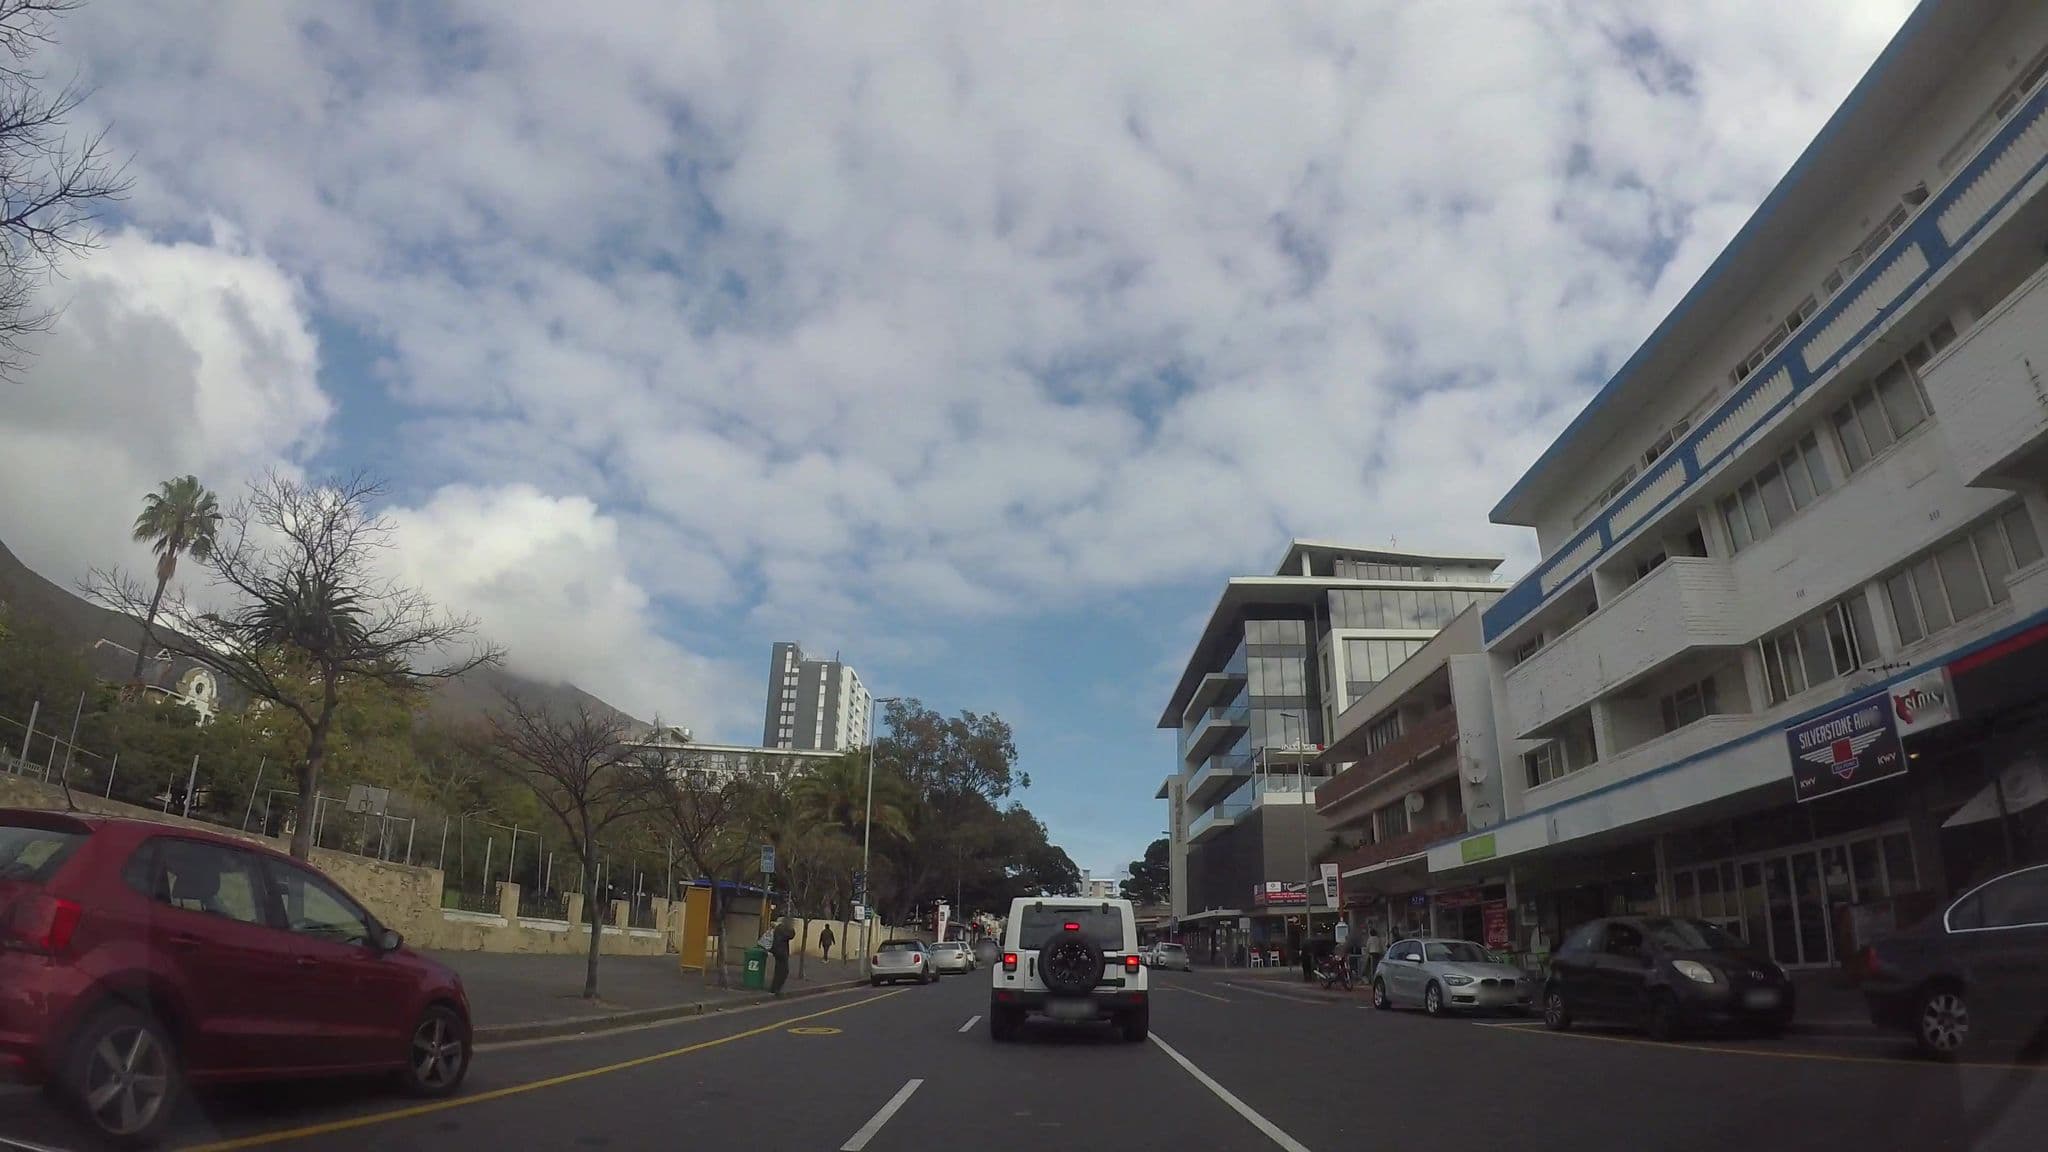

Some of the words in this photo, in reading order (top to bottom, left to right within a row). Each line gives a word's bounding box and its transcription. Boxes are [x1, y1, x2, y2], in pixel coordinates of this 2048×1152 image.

[1798, 716, 1854, 750] SILVERSTONE
[1877, 752, 1897, 765] KWV
[1799, 776, 1816, 789] KWV
